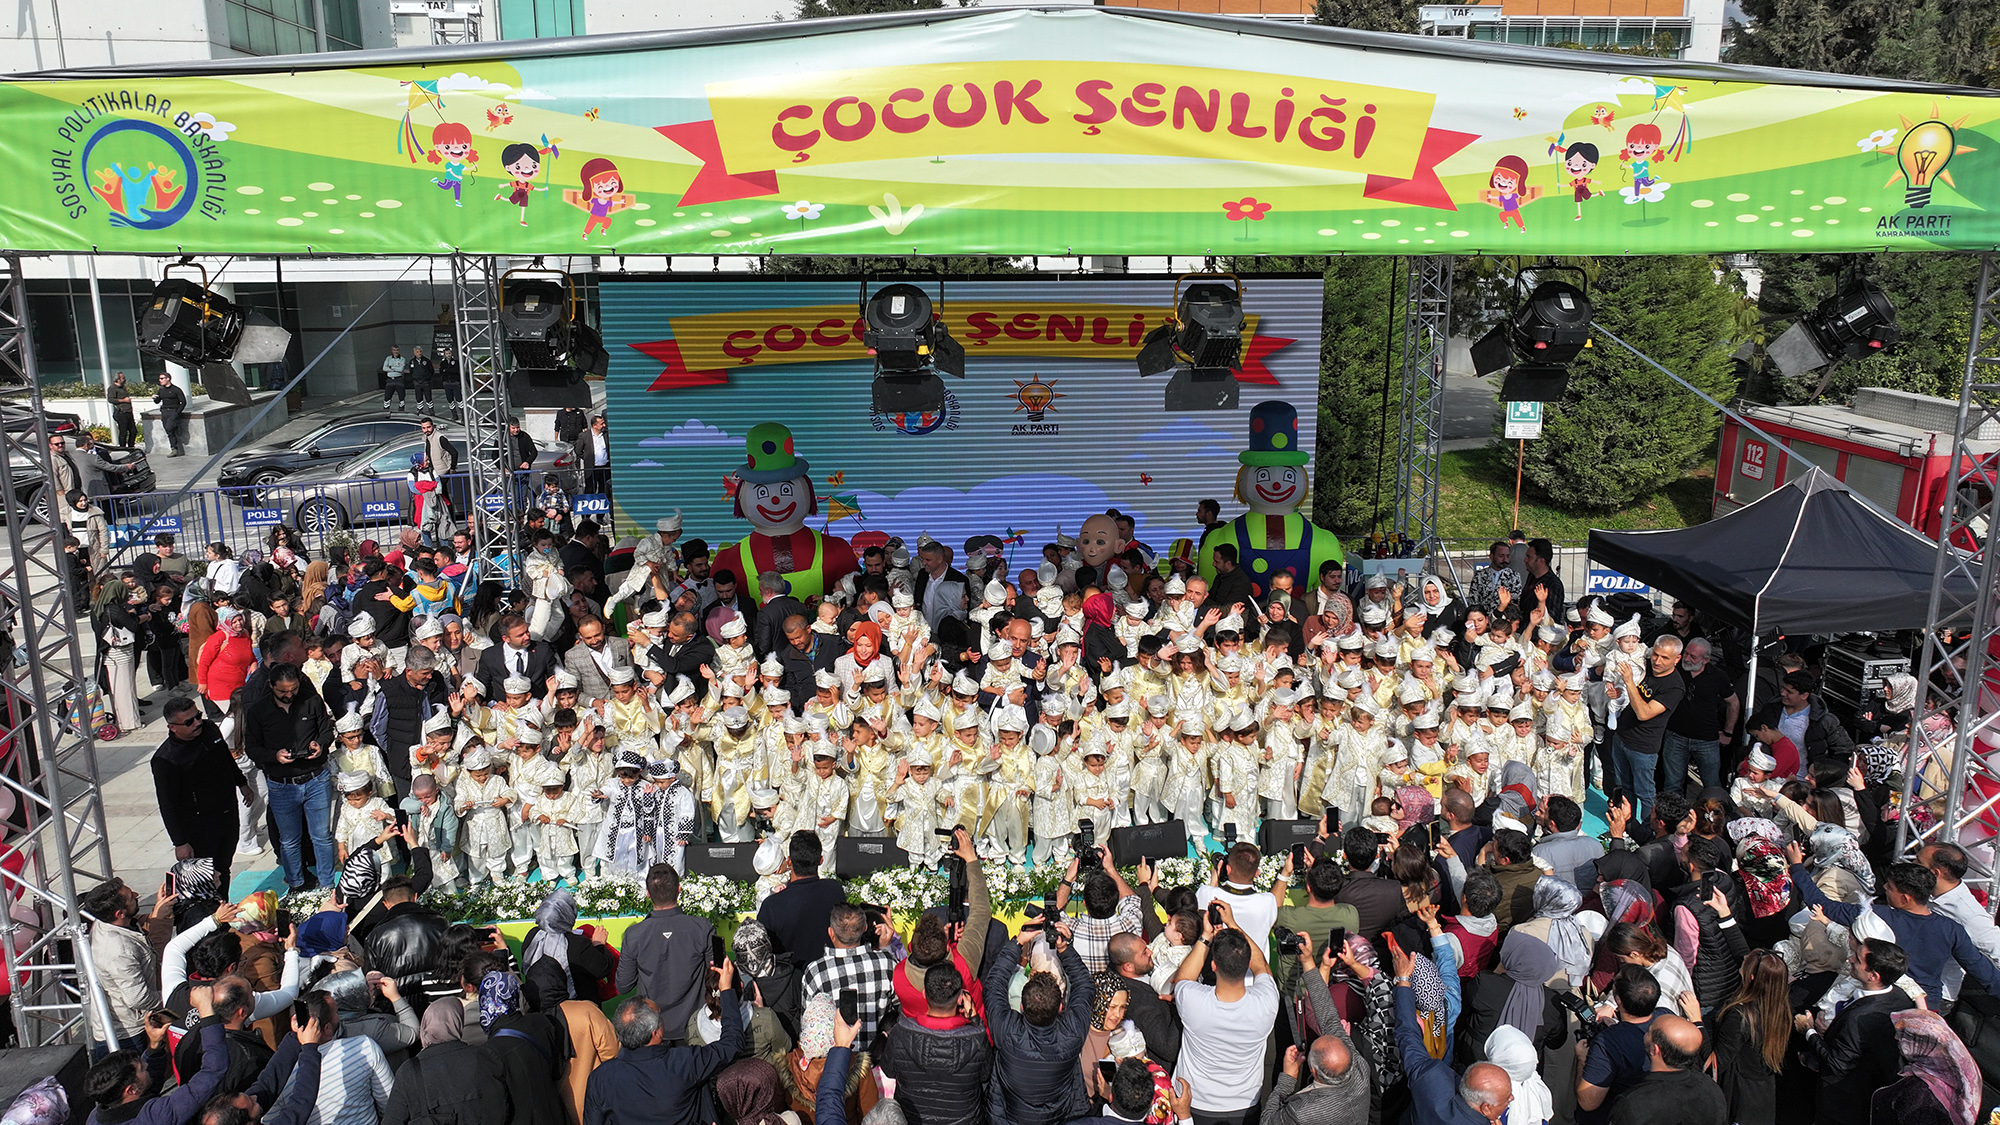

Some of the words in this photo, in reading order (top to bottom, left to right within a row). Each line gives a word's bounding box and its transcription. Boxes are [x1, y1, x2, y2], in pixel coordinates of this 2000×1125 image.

[58, 90, 171, 143] POLİTİKALAR
[772, 79, 1050, 163] ÇOCUK
[1073, 79, 1377, 159] ŞENLİĞİ
[51, 149, 87, 219] SOSYAL
[173, 111, 227, 221] BAŞKANLIĞI
[1876, 215, 1900, 229] AK
[722, 313, 940, 364] ÇOC
[1746, 443, 1764, 464] 112
